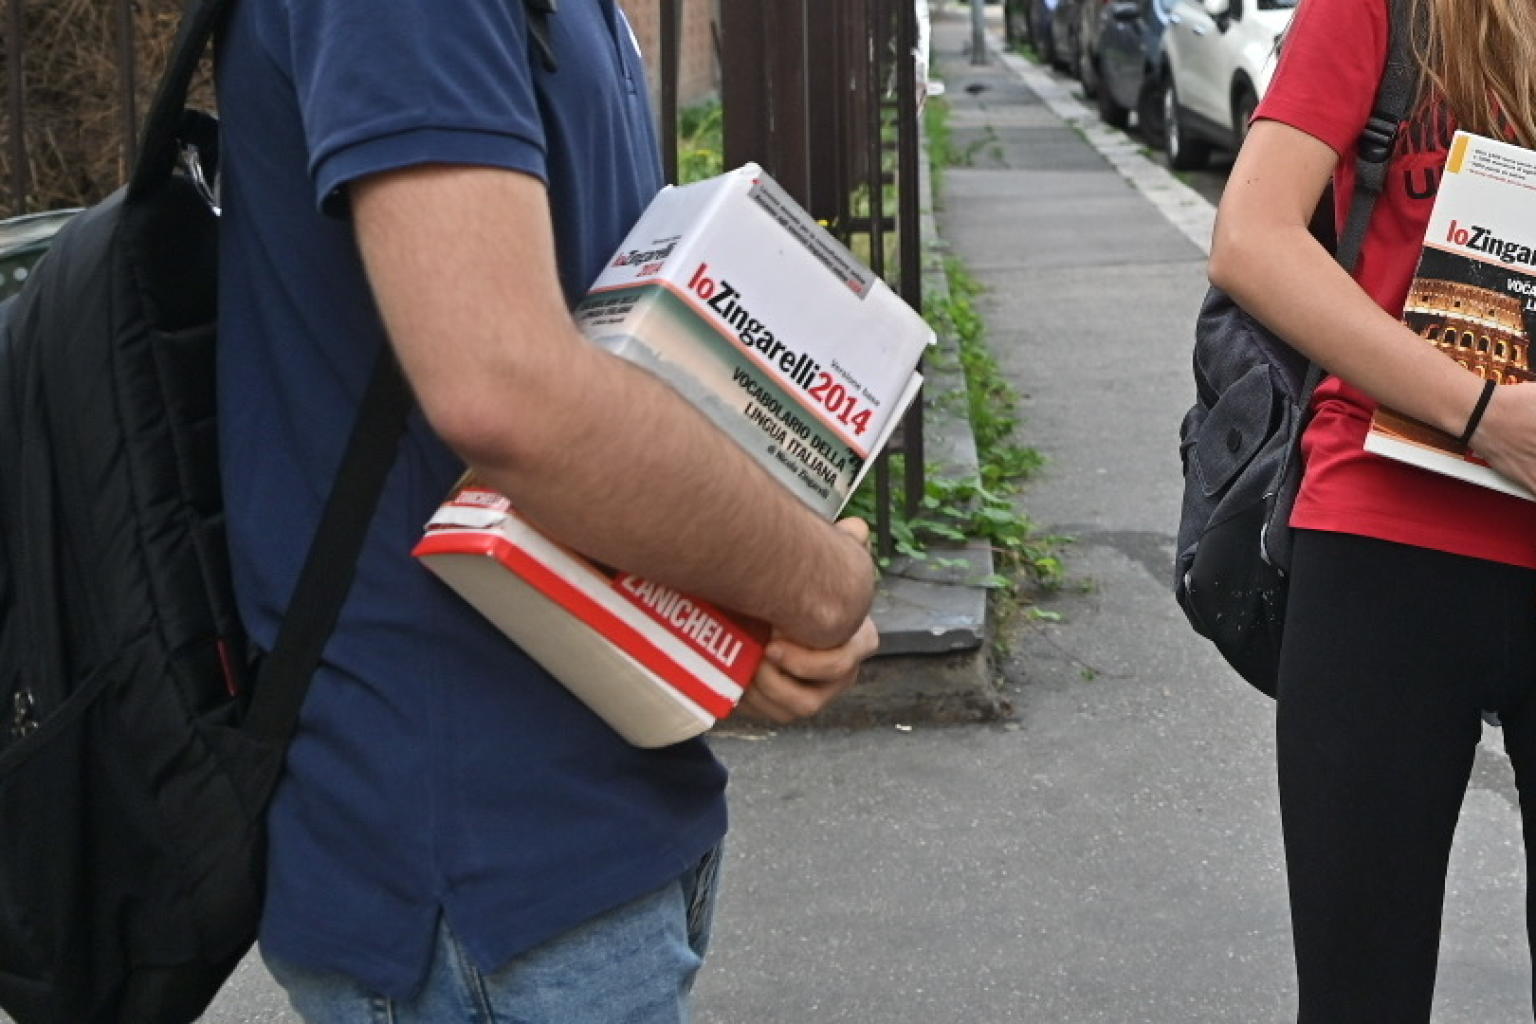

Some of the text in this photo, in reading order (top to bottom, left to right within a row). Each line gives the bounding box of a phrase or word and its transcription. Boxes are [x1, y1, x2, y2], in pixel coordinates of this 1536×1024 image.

[732, 365, 846, 472] VOCABOLARIO DELLA
[744, 401, 838, 488] LINGUA ITALIANA
